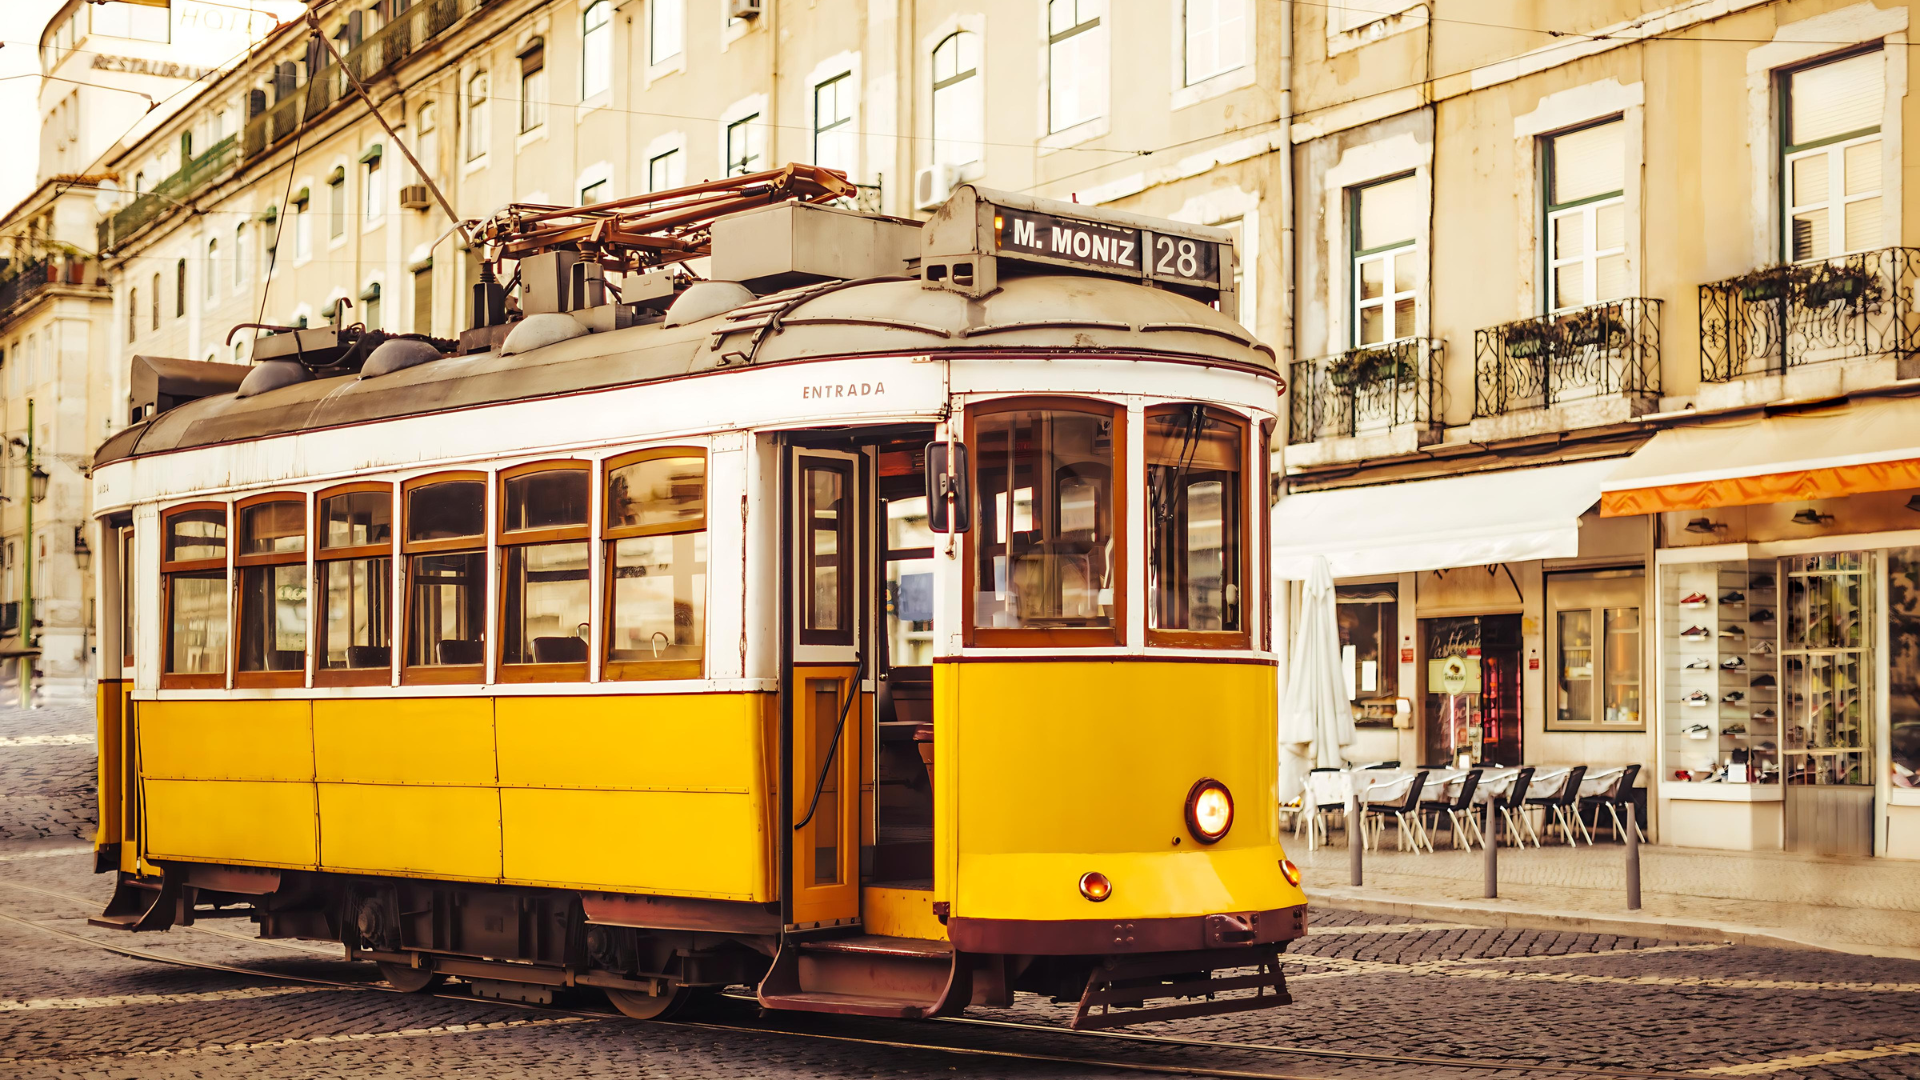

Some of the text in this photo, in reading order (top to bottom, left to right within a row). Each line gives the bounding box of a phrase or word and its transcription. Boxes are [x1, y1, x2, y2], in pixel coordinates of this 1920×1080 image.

[1013, 218, 1043, 249] M.
[1051, 225, 1135, 267] MONIZ
[1156, 236, 1197, 278] 28
[803, 381, 885, 399] ENTRADA
